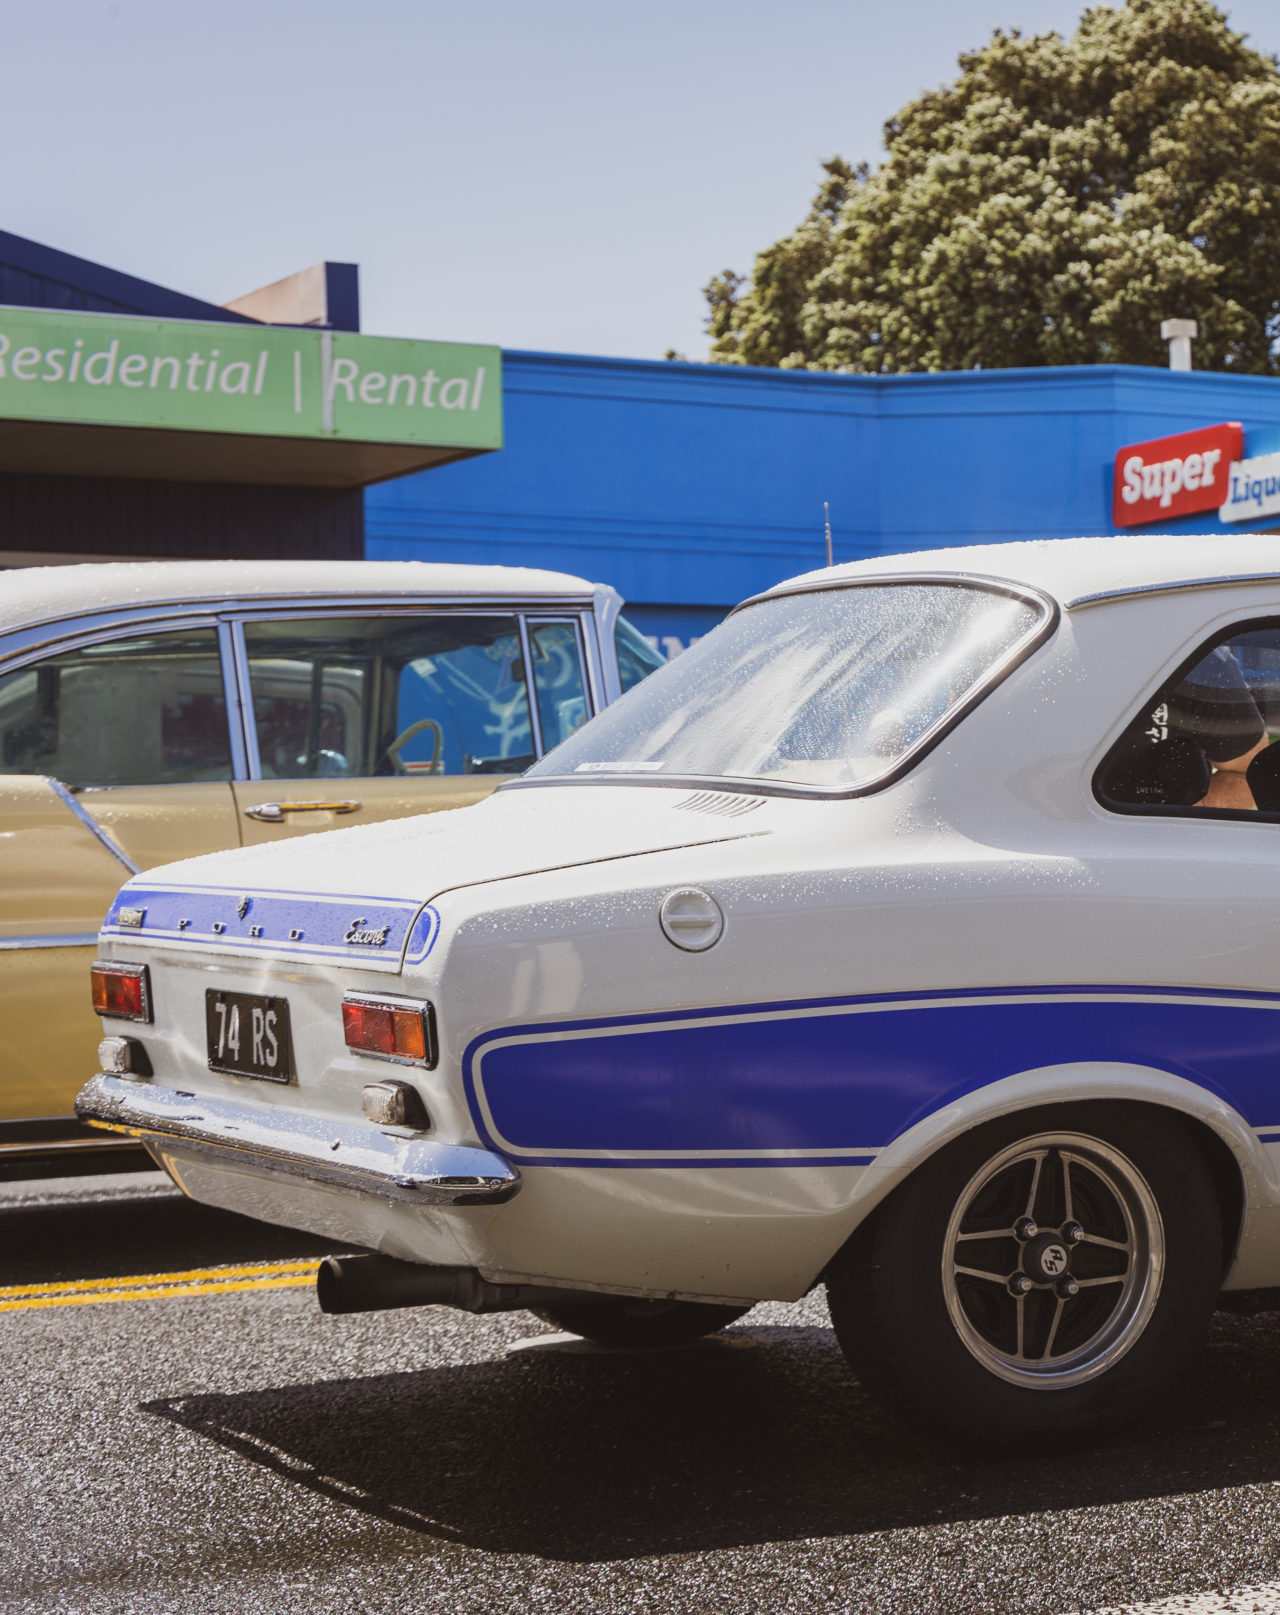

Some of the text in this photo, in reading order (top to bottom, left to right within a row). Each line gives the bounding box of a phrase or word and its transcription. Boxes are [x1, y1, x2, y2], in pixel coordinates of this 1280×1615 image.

[328, 357, 486, 411] Rental
[1121, 448, 1222, 508] Super
[343, 917, 390, 945] Escort
[215, 1002, 278, 1067] 74 RS
